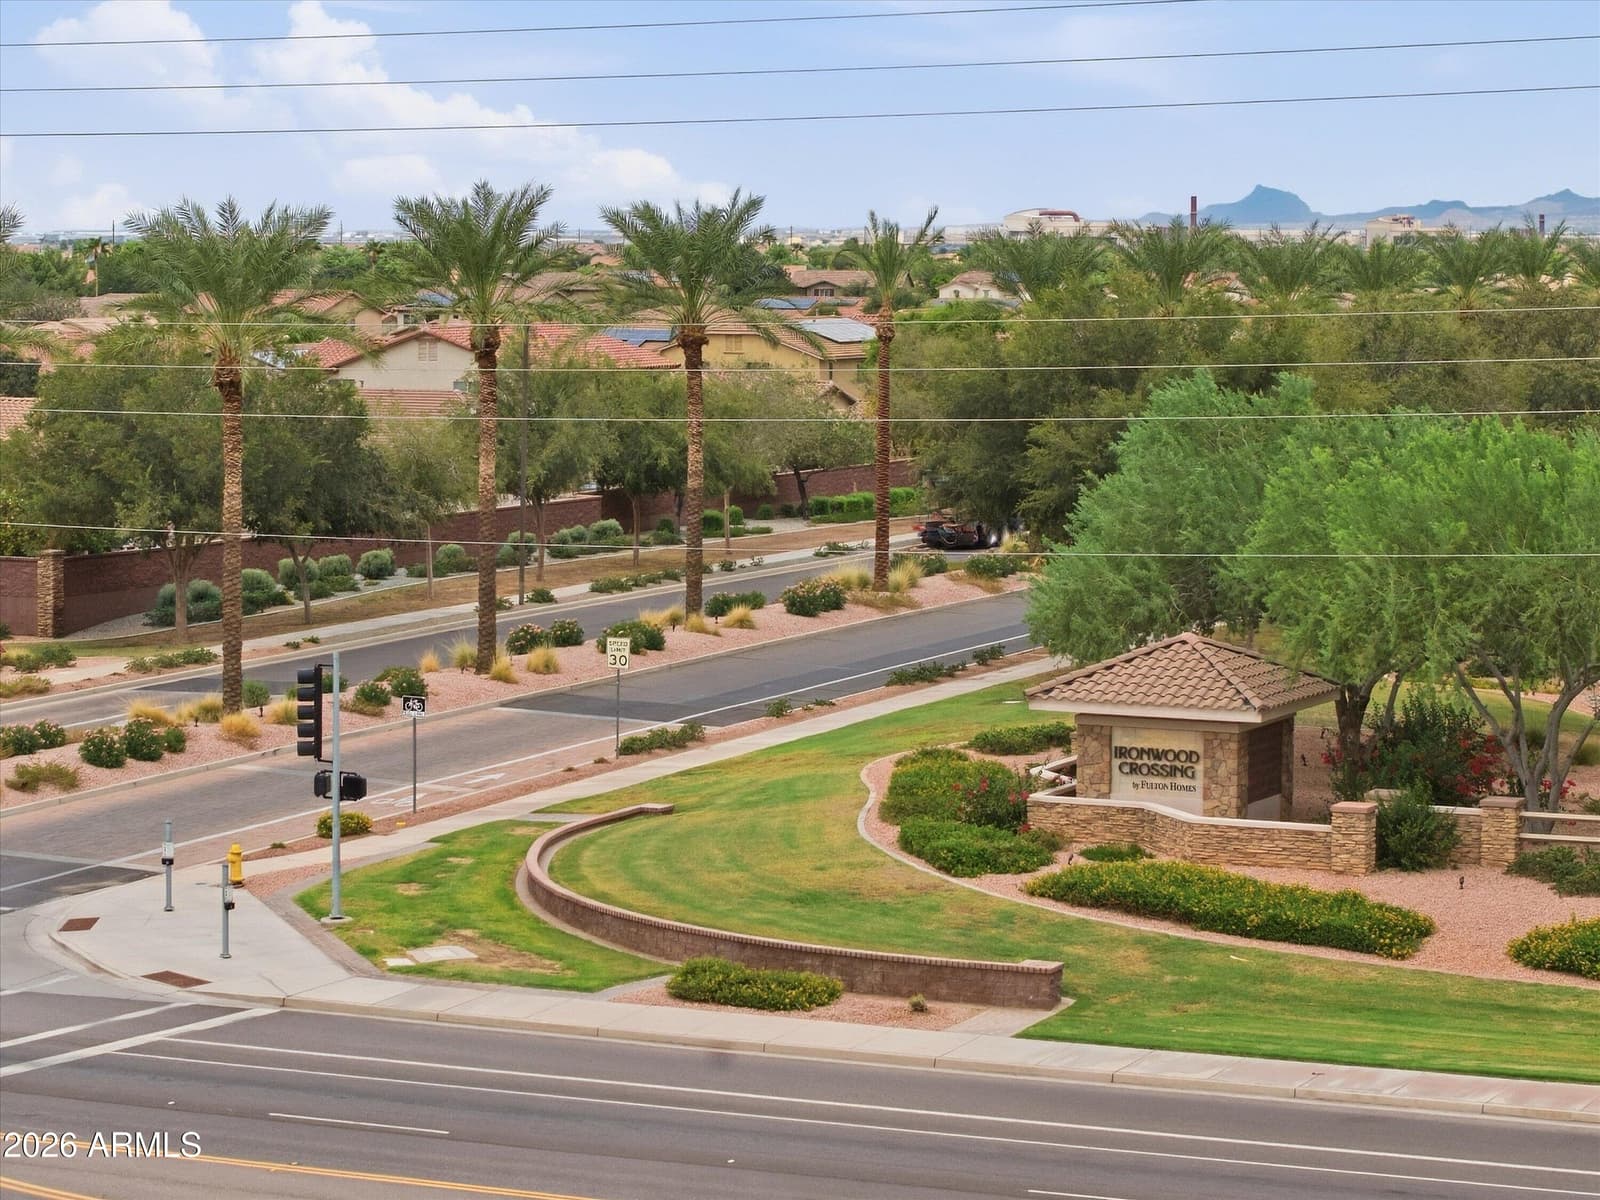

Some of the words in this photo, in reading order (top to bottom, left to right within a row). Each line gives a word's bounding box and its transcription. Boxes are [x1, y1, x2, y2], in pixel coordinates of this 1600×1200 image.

[609, 654, 627, 666] 30
[1114, 746, 1200, 764] IRONWOOD
[1118, 761, 1196, 779] CROSSING
[1132, 781, 1139, 790] by
[1141, 780, 1169, 790] FULTON
[1170, 782, 1196, 792] HOMES
